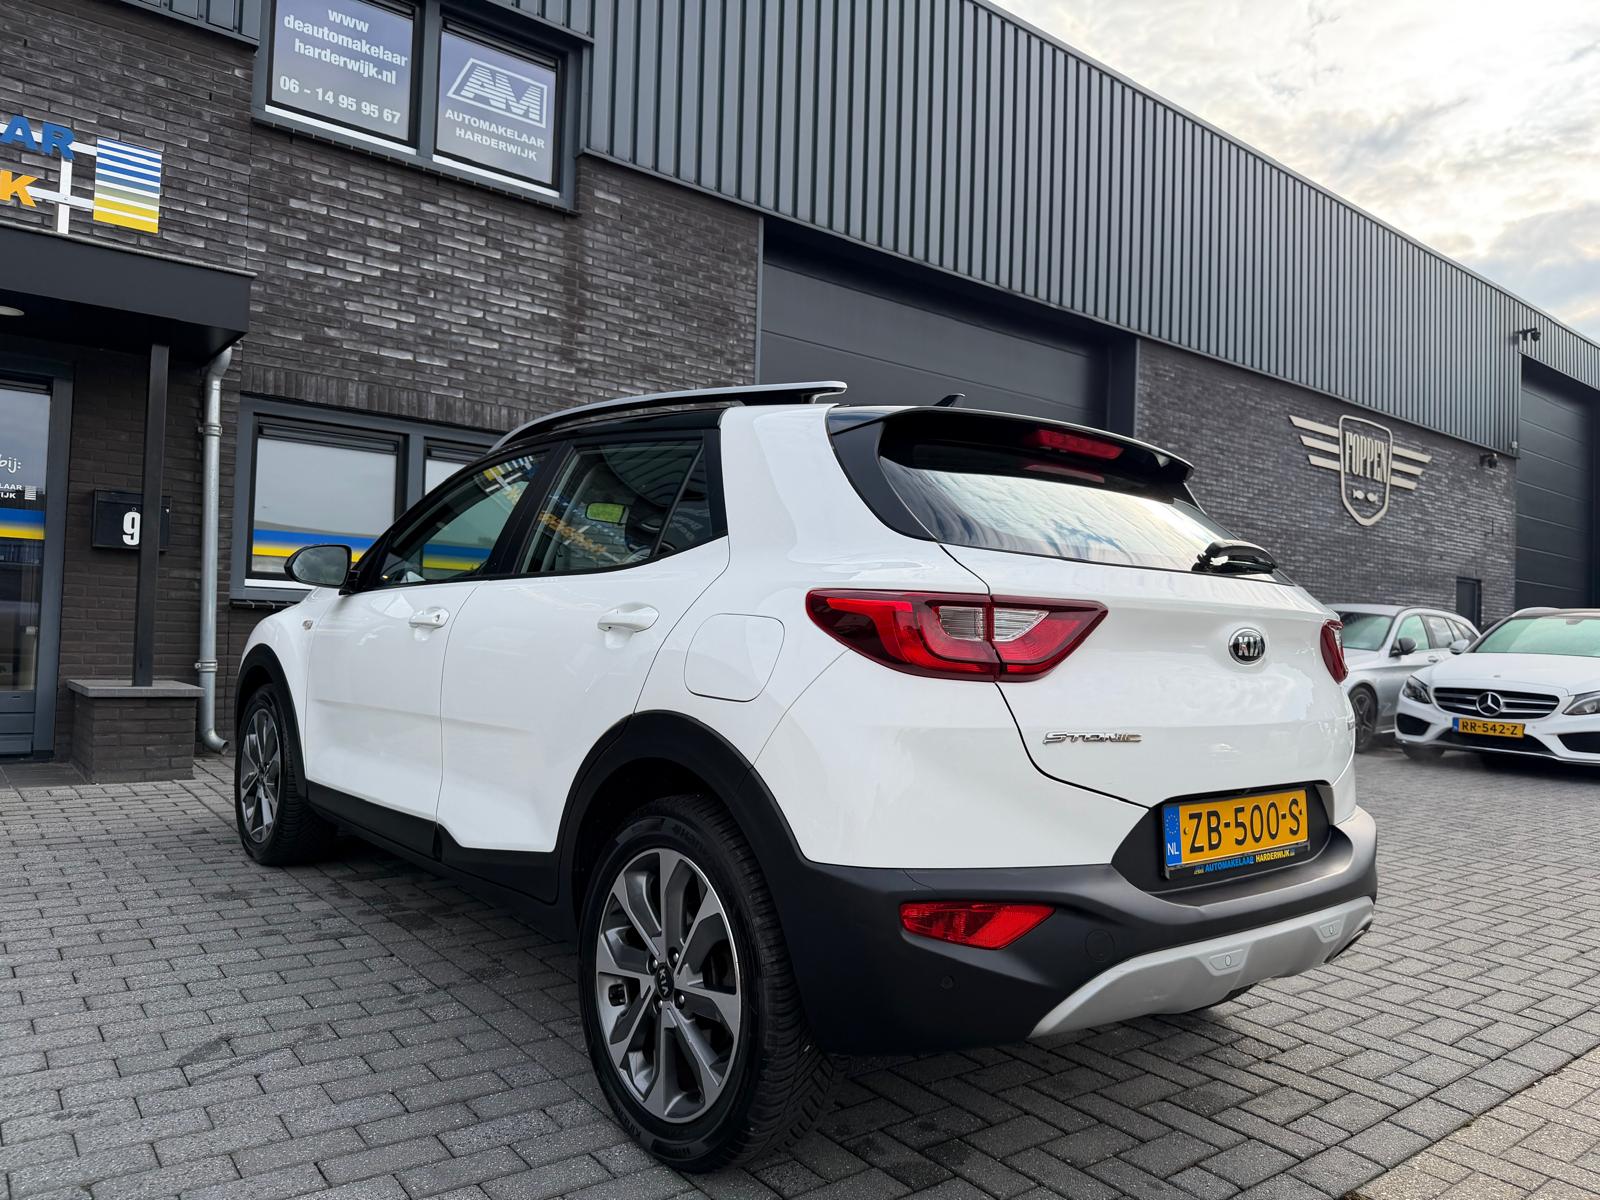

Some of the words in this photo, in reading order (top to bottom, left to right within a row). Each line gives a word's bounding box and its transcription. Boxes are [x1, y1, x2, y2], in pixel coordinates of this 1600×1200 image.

[328, 9, 369, 32] www
[284, 14, 408, 67] deautomakelaar
[294, 38, 397, 85] harderwijk.nl
[279, 75, 300, 94] 06
[316, 88, 334, 105] 14
[339, 94, 357, 112] 95
[361, 101, 379, 119] 95
[383, 107, 401, 125] 67
[445, 109, 545, 149] AUTOMAKELAAR
[455, 127, 537, 161] HARDERWIJK
[1344, 431, 1388, 483] FOPPEN
[122, 511, 141, 546] 9
[1237, 636, 1263, 656] KIA
[1043, 731, 1142, 745] STONIC
[1462, 721, 1518, 735] RR-542-Z
[1188, 798, 1302, 854] ZB-500-S
[1167, 842, 1180, 856] NL
[1205, 856, 1254, 873] AUTOMAKELAAR
[1255, 850, 1290, 863] HARDERWIJK
[659, 968, 669, 996] KIA
